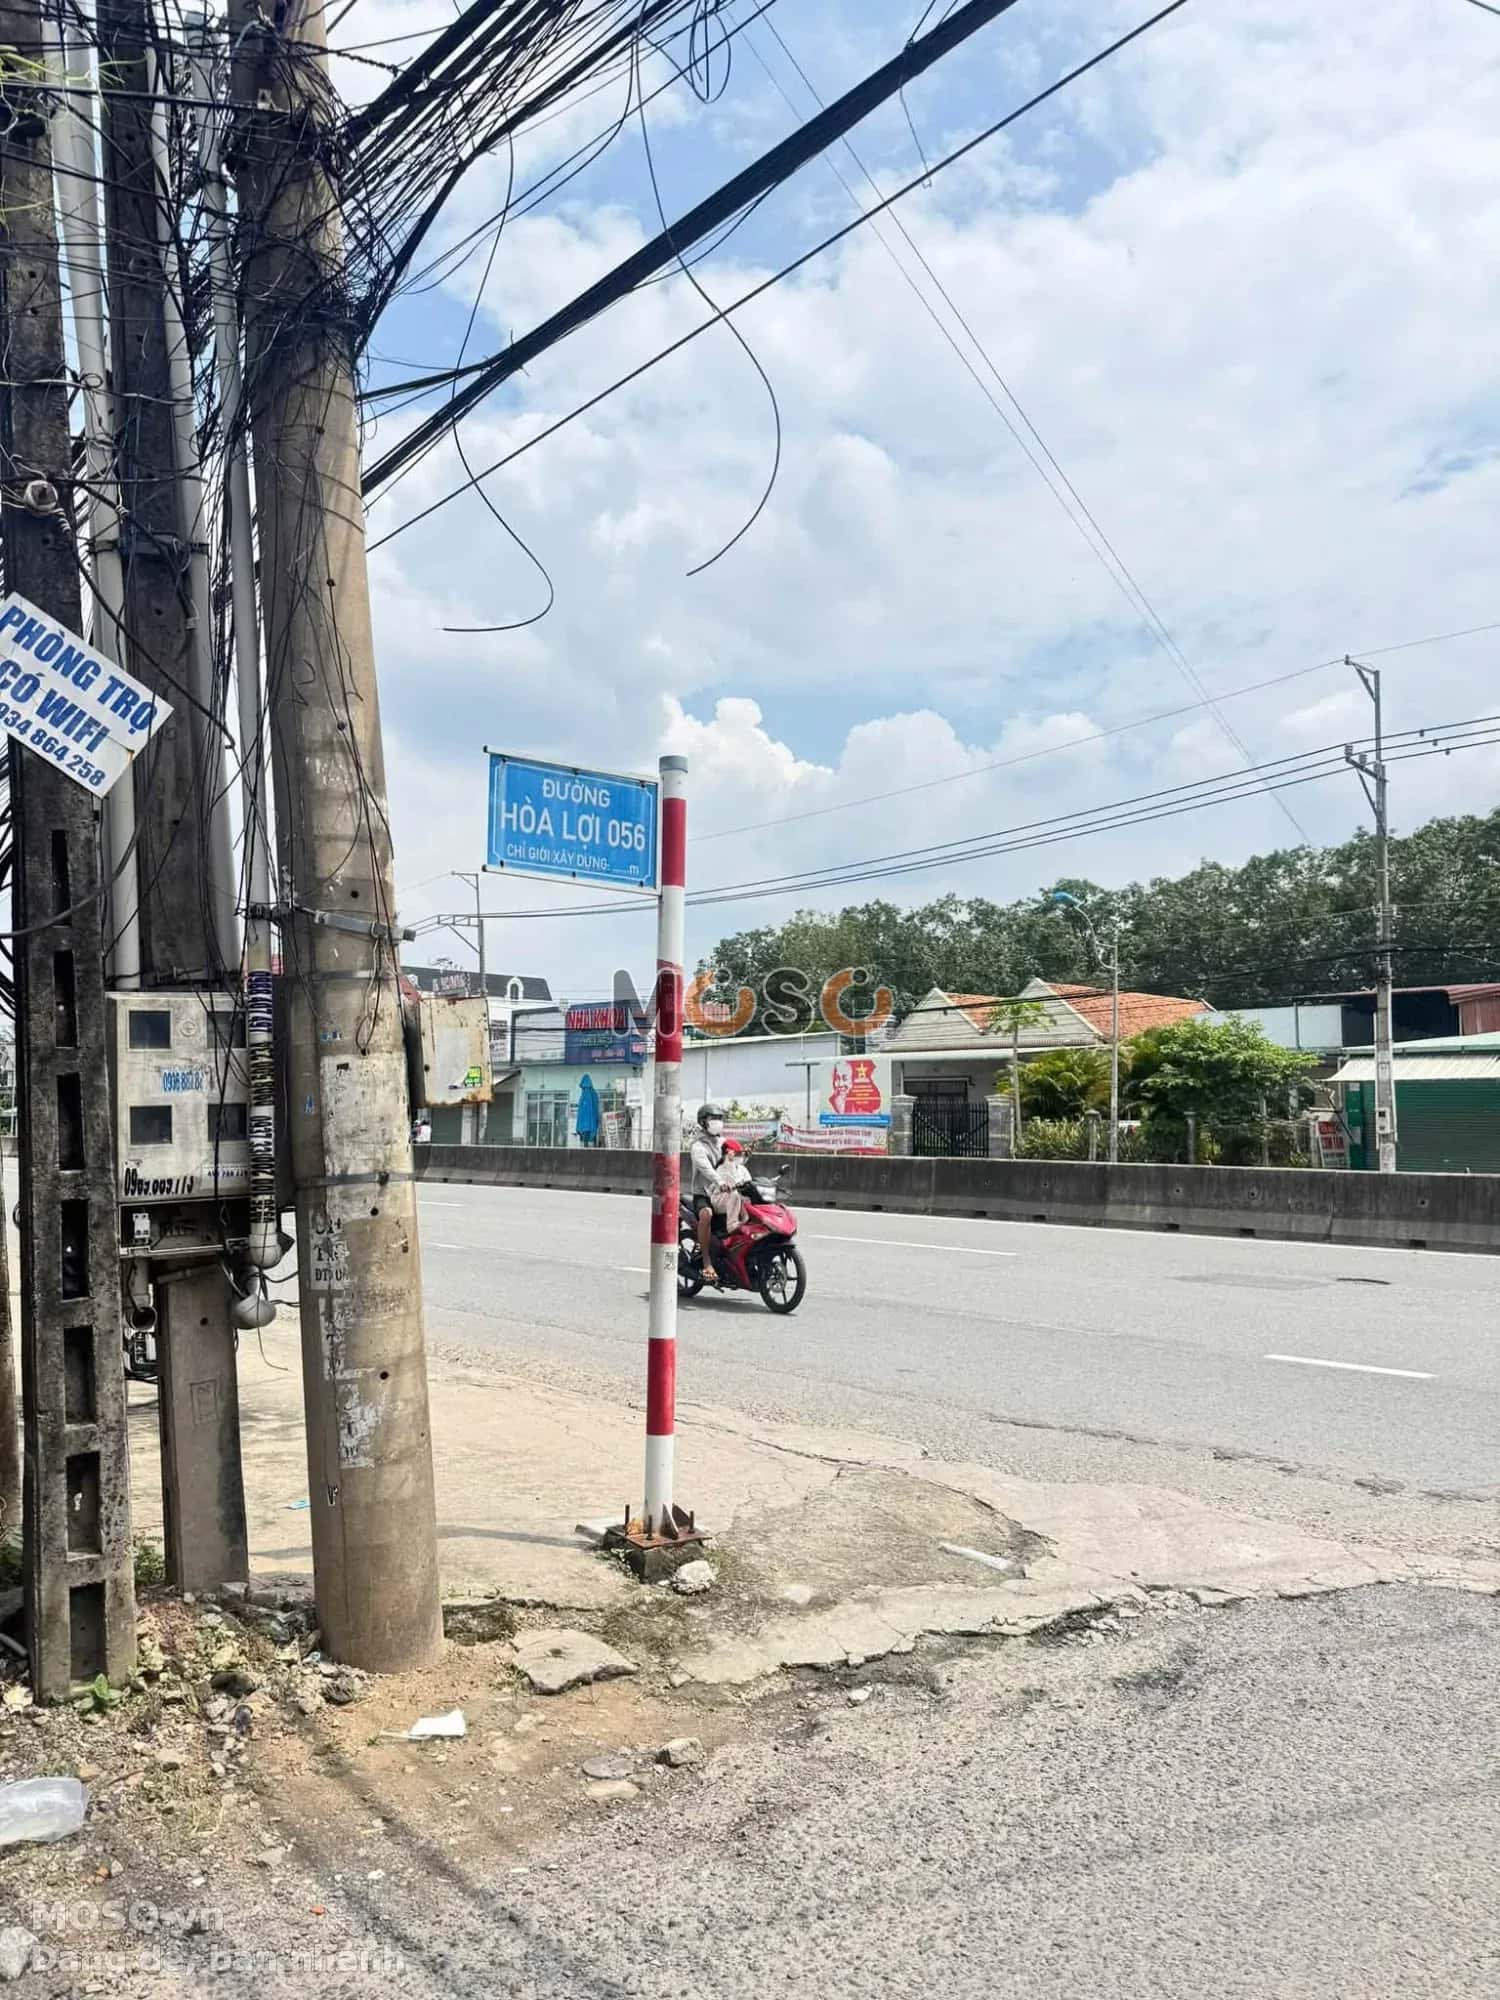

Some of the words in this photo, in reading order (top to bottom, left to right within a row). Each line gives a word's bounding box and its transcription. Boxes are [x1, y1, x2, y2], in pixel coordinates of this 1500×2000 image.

[0, 606, 101, 692] PHÒNG
[97, 675, 158, 735] TRỌ
[0, 660, 46, 704] CÓ
[36, 688, 110, 753] WIFI
[30, 728, 70, 761] 864
[66, 754, 106, 786] 258
[542, 778, 611, 808] ĐƯỜNG
[500, 796, 554, 837] HÒA
[562, 811, 600, 850] LỢI
[608, 818, 646, 851] 056
